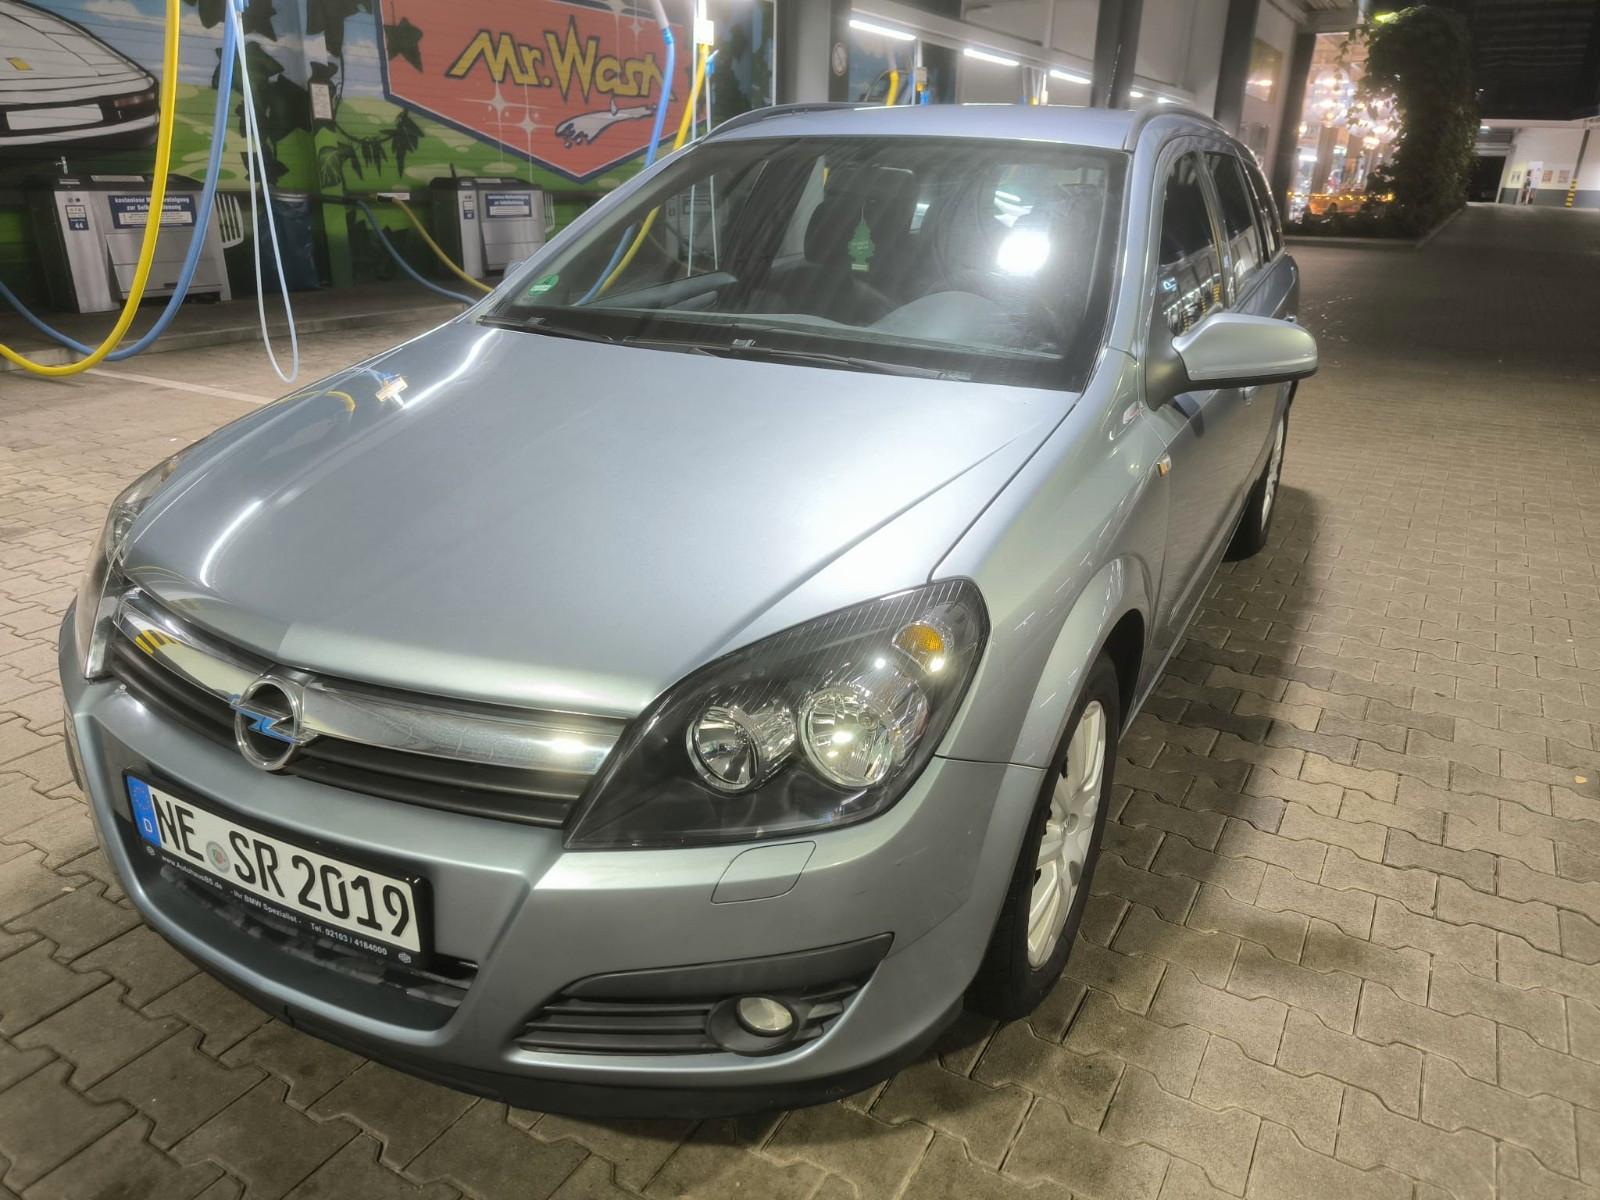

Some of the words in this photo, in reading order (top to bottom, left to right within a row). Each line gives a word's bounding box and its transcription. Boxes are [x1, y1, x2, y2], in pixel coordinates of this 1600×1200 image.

[151, 793, 205, 863] NE
[228, 830, 286, 898] SR
[291, 854, 410, 937] 2019
[244, 894, 262, 908] BMW
[263, 903, 298, 923] Spezialist
